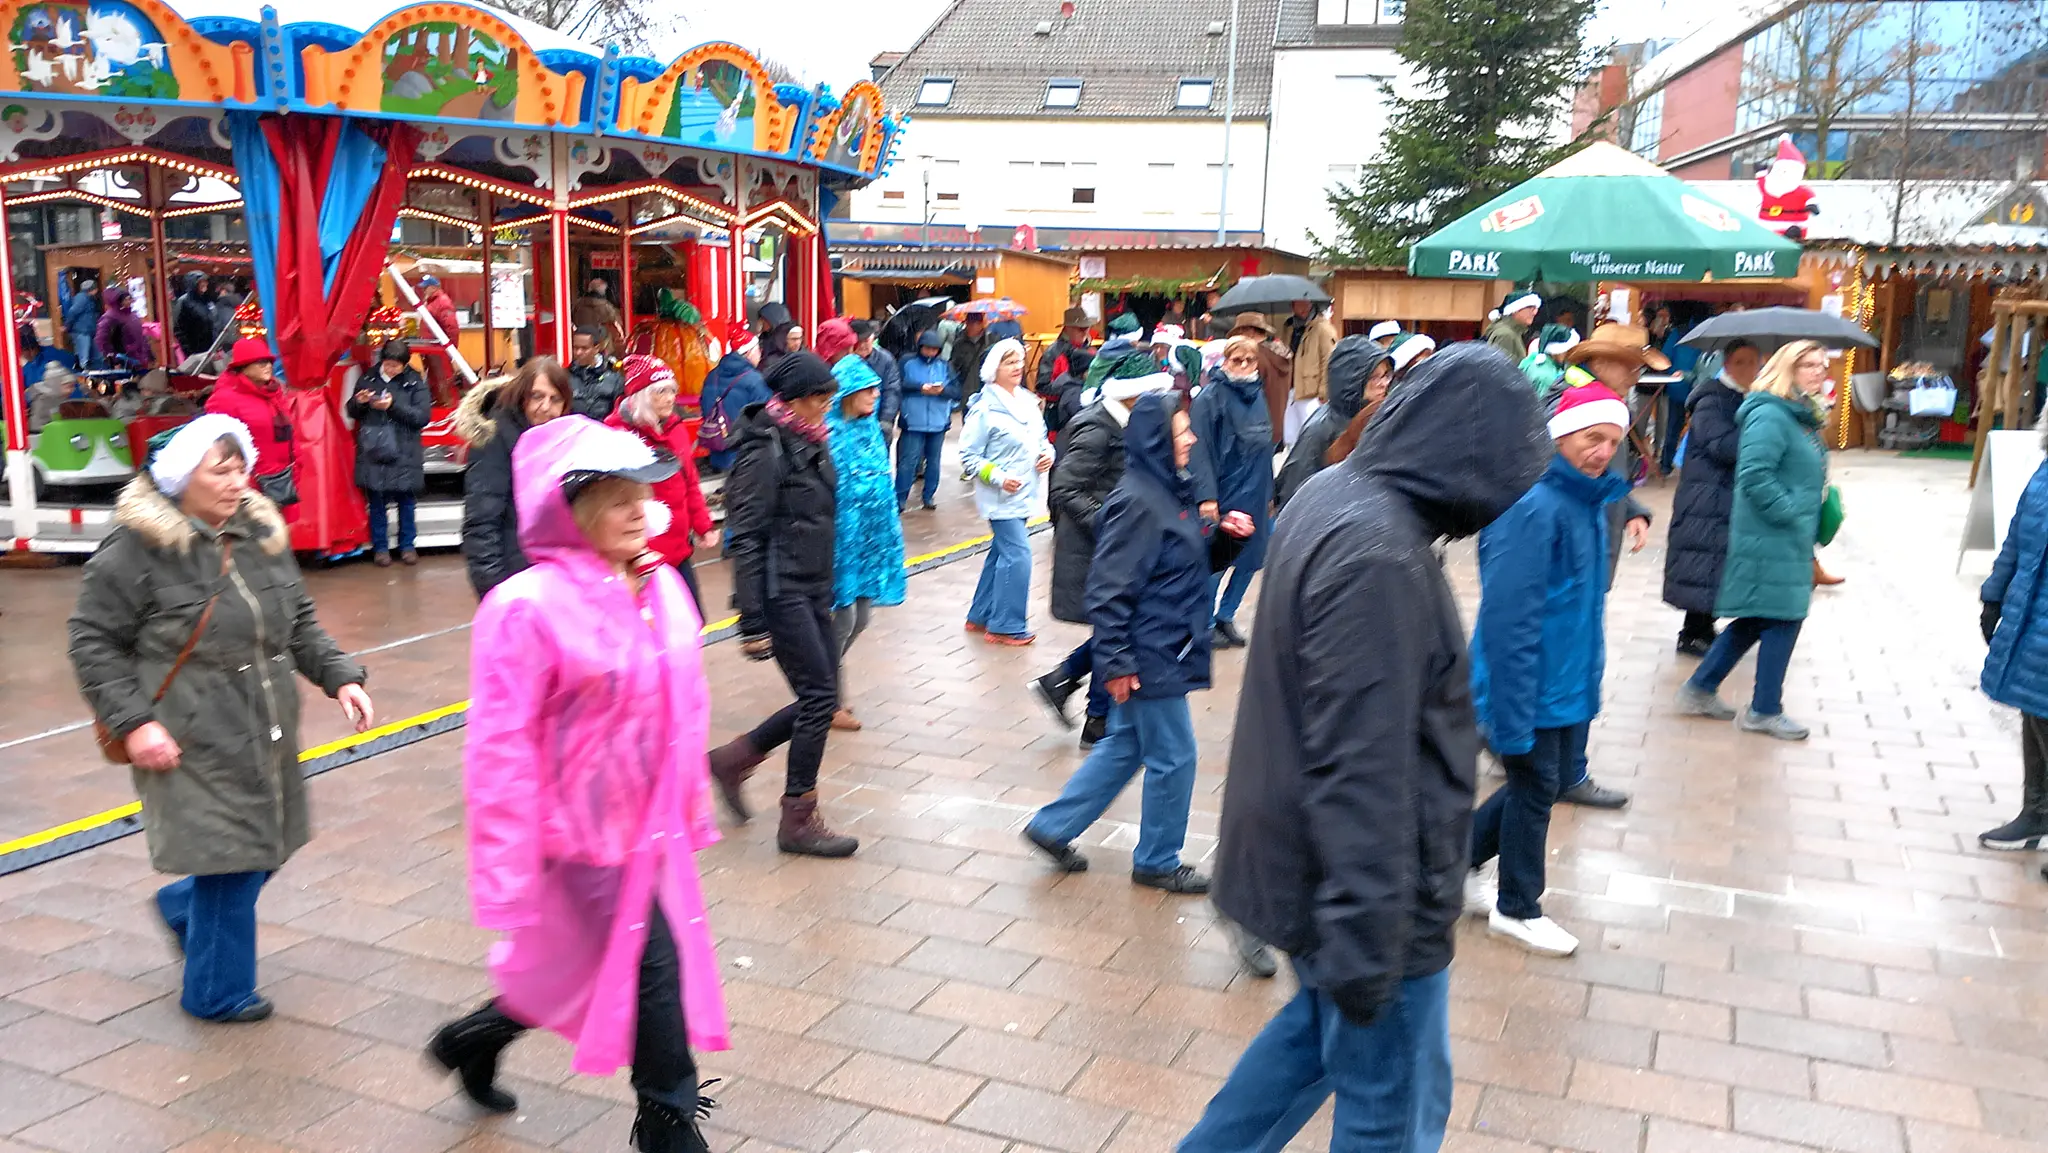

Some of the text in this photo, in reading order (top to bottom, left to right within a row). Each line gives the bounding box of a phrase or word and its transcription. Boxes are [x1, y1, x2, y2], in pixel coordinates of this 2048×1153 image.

[1598, 250, 1611, 263] in
[1591, 259, 1685, 275] unserer Natur
